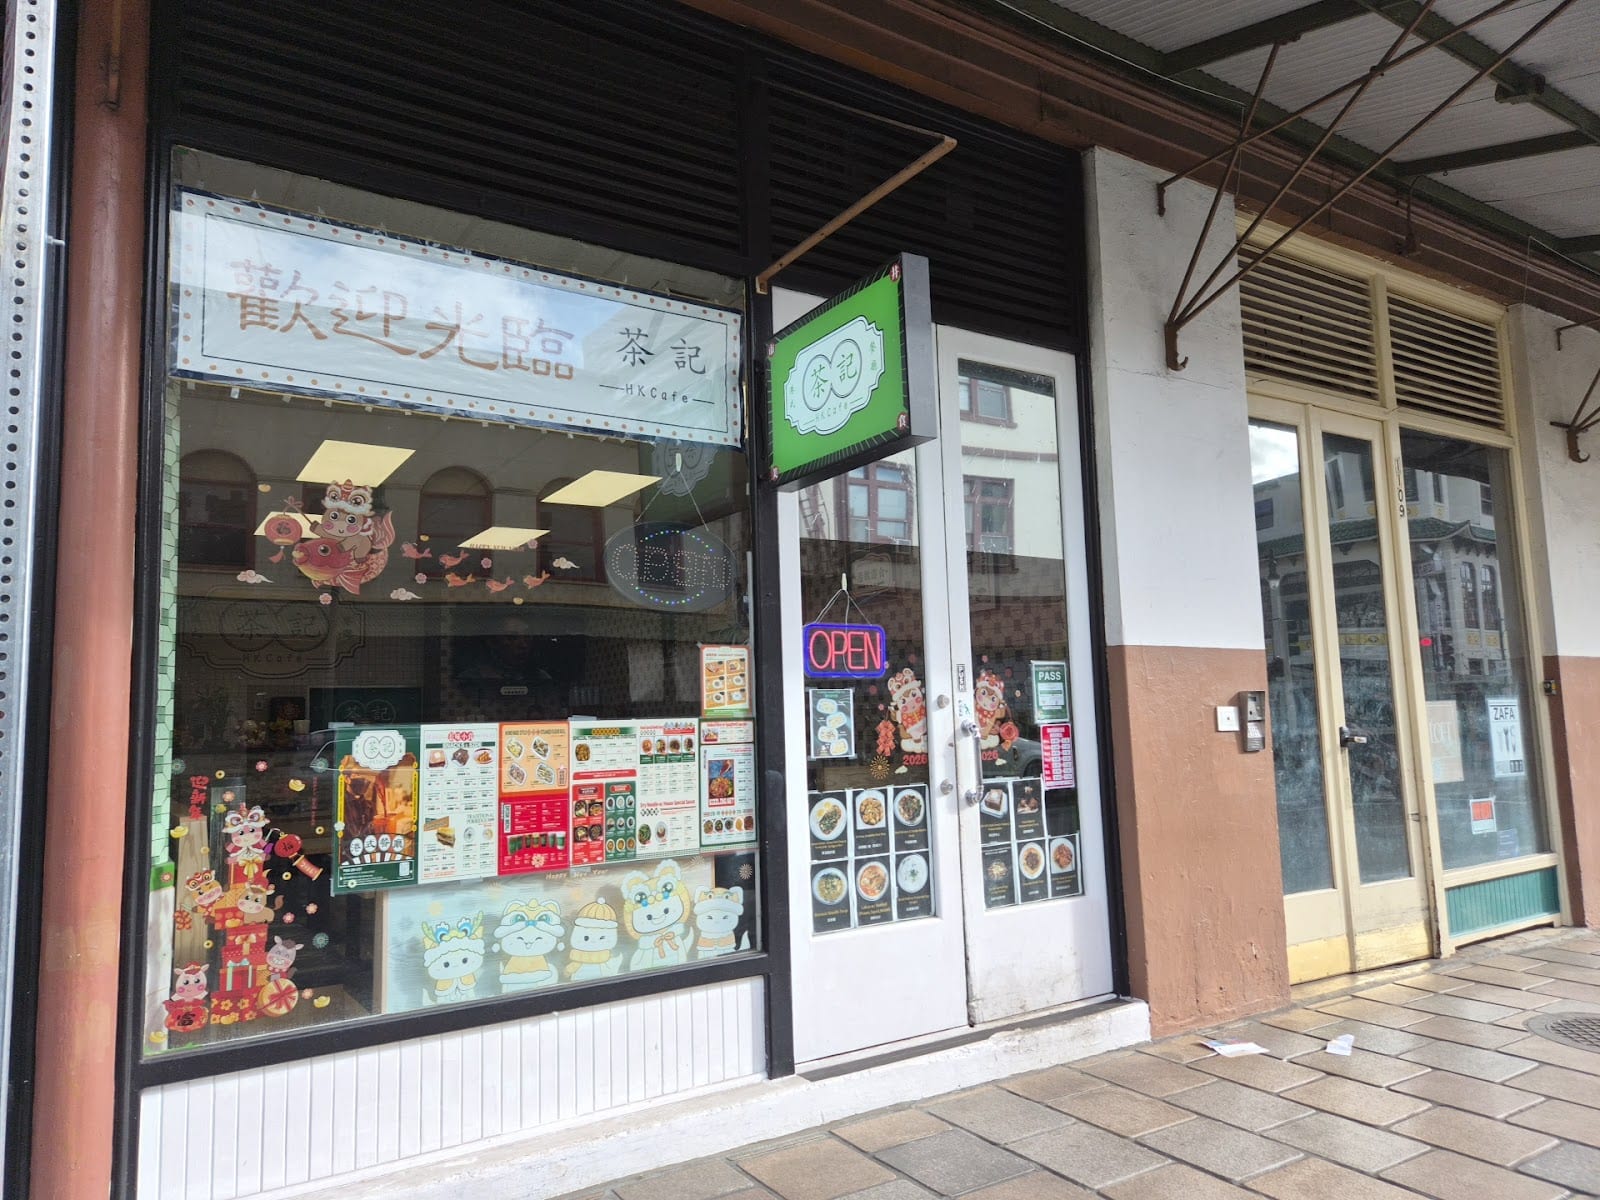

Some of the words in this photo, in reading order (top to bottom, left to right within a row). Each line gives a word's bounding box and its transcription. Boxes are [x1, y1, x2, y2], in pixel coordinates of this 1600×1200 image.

[227, 257, 575, 381] 歡迎光臨
[615, 327, 707, 376] 茶記
[811, 352, 858, 399] 茶記
[809, 630, 881, 670] OPEN
[1038, 671, 1062, 681] PASS
[1493, 707, 1516, 721] ZAFA
[903, 754, 927, 766] 2026
[981, 750, 999, 761] 026
